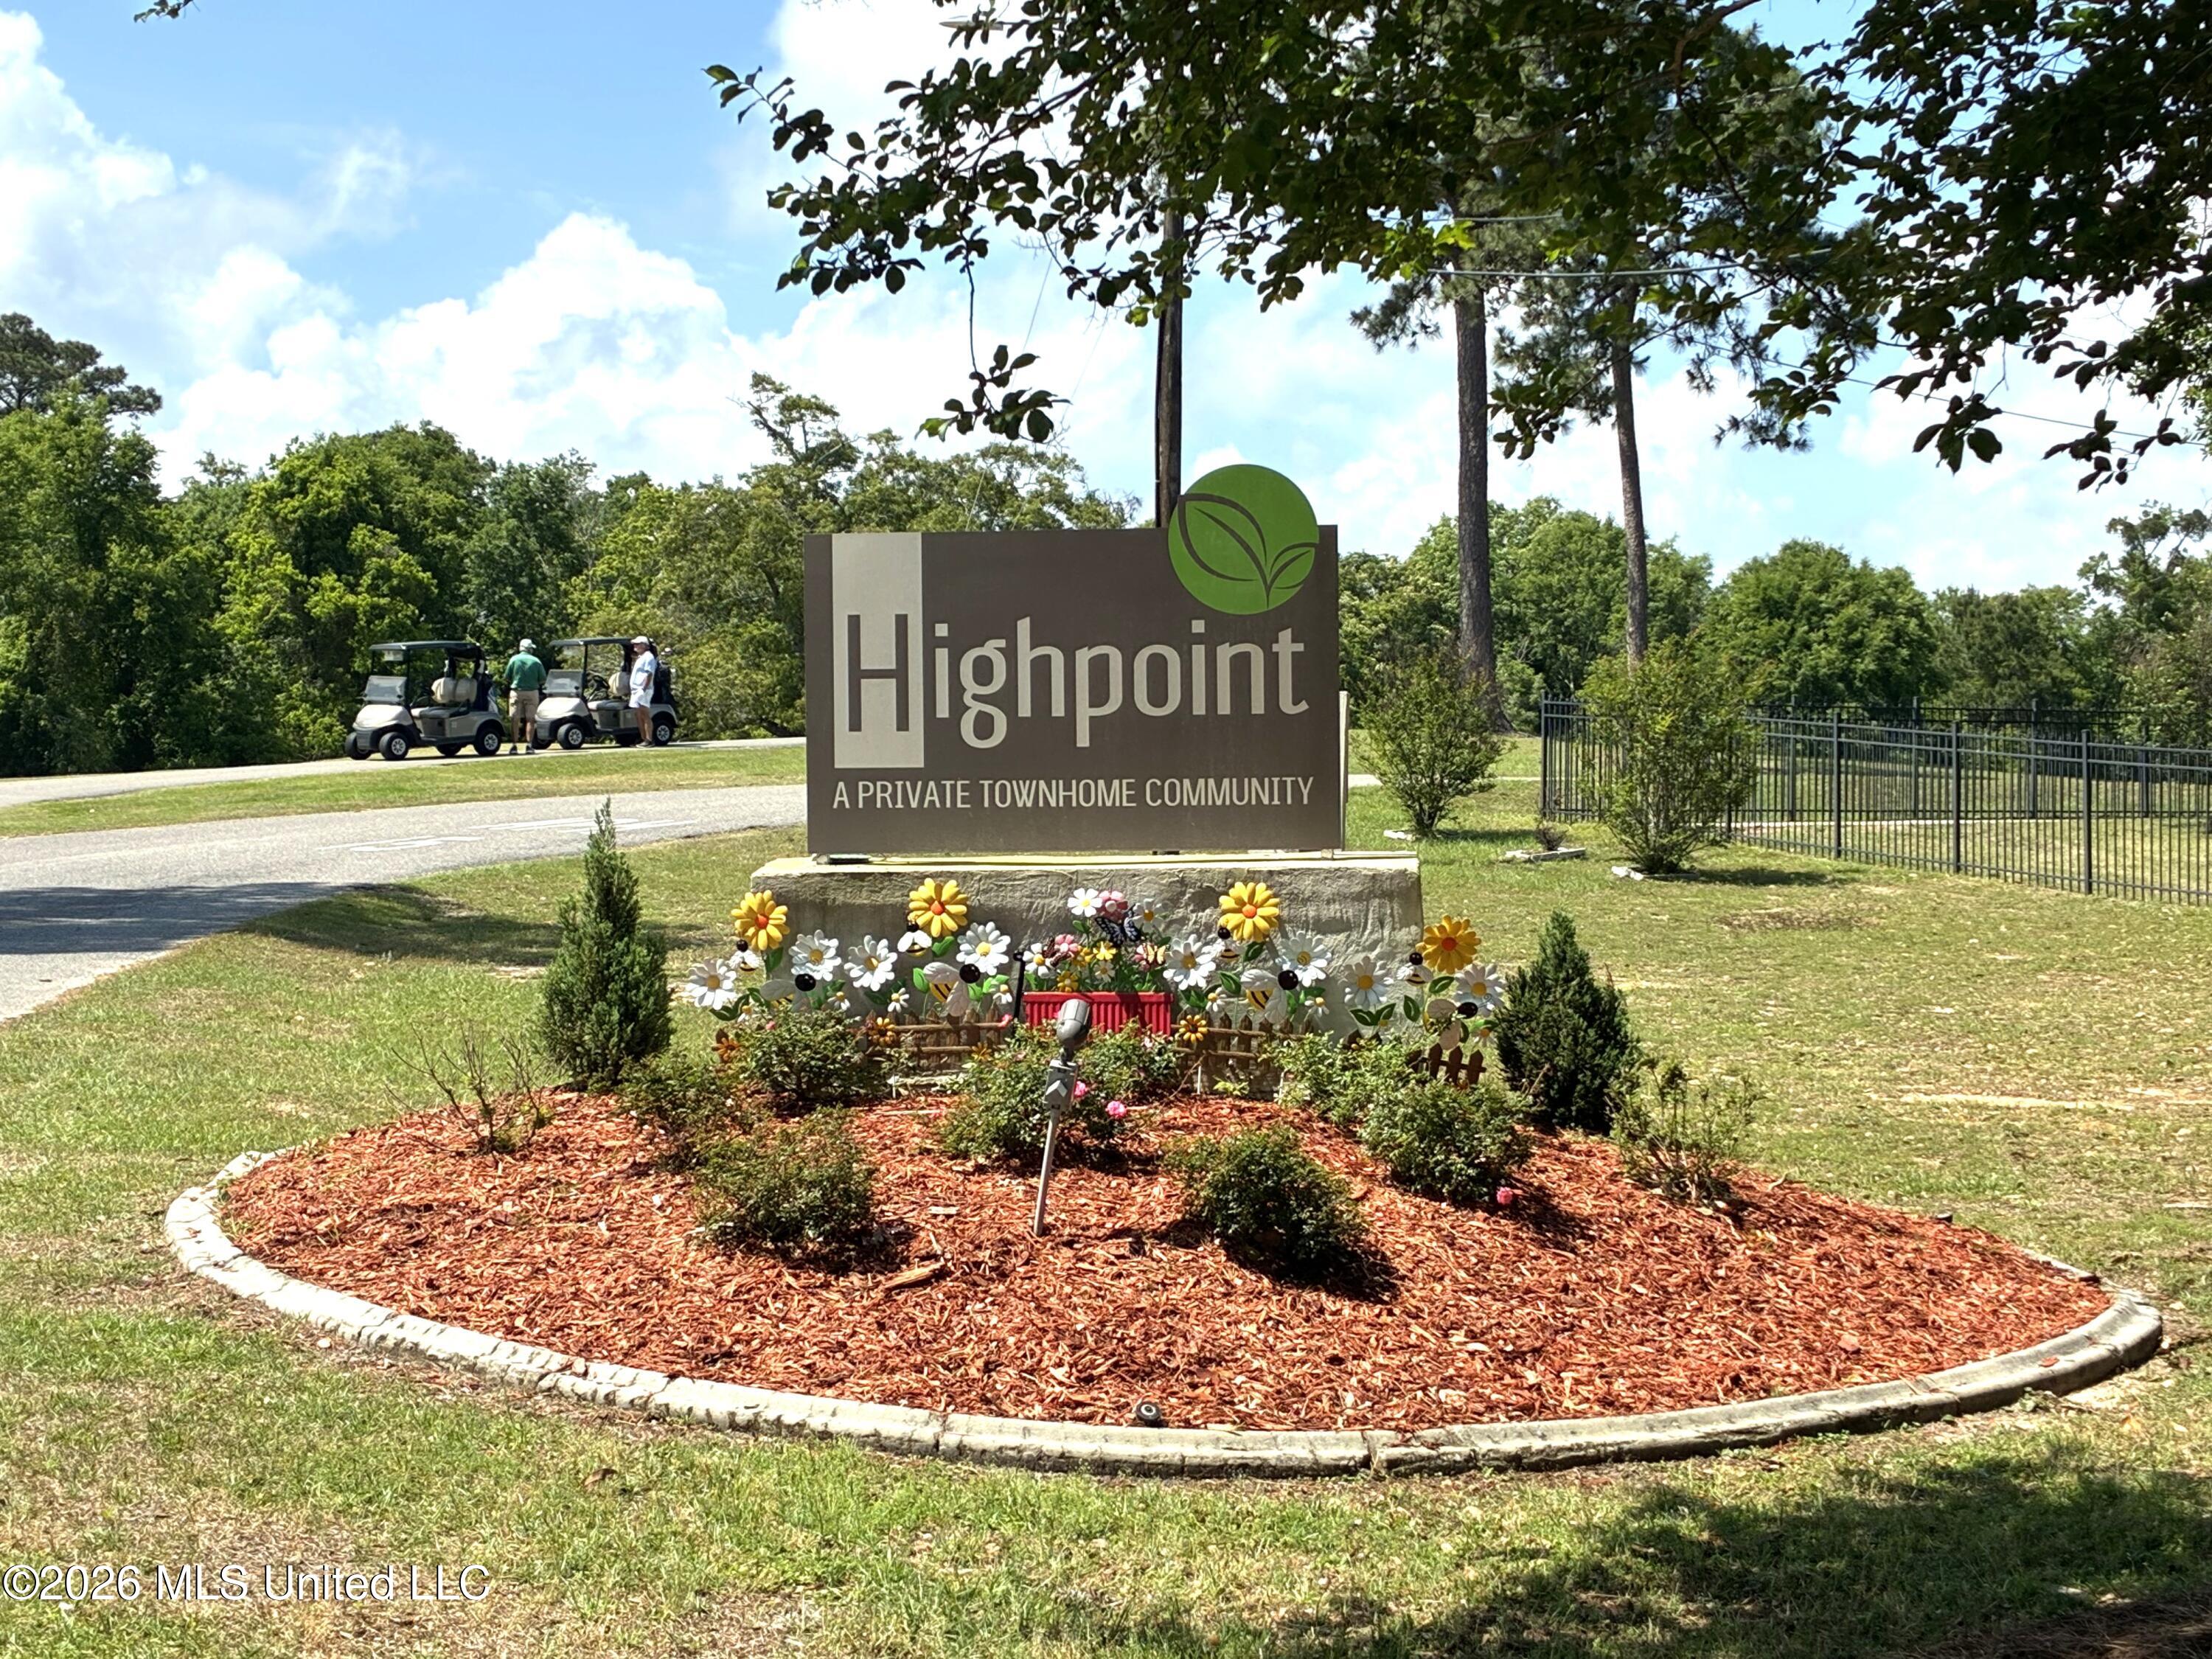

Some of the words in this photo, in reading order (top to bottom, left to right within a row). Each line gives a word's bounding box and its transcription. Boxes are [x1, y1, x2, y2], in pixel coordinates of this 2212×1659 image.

[847, 613, 1310, 749] Highpoint
[832, 781, 850, 809] A
[858, 781, 971, 809] PRIVATE
[979, 779, 1137, 807] TOWNHOME
[1145, 776, 1314, 807] COMMUNITY
